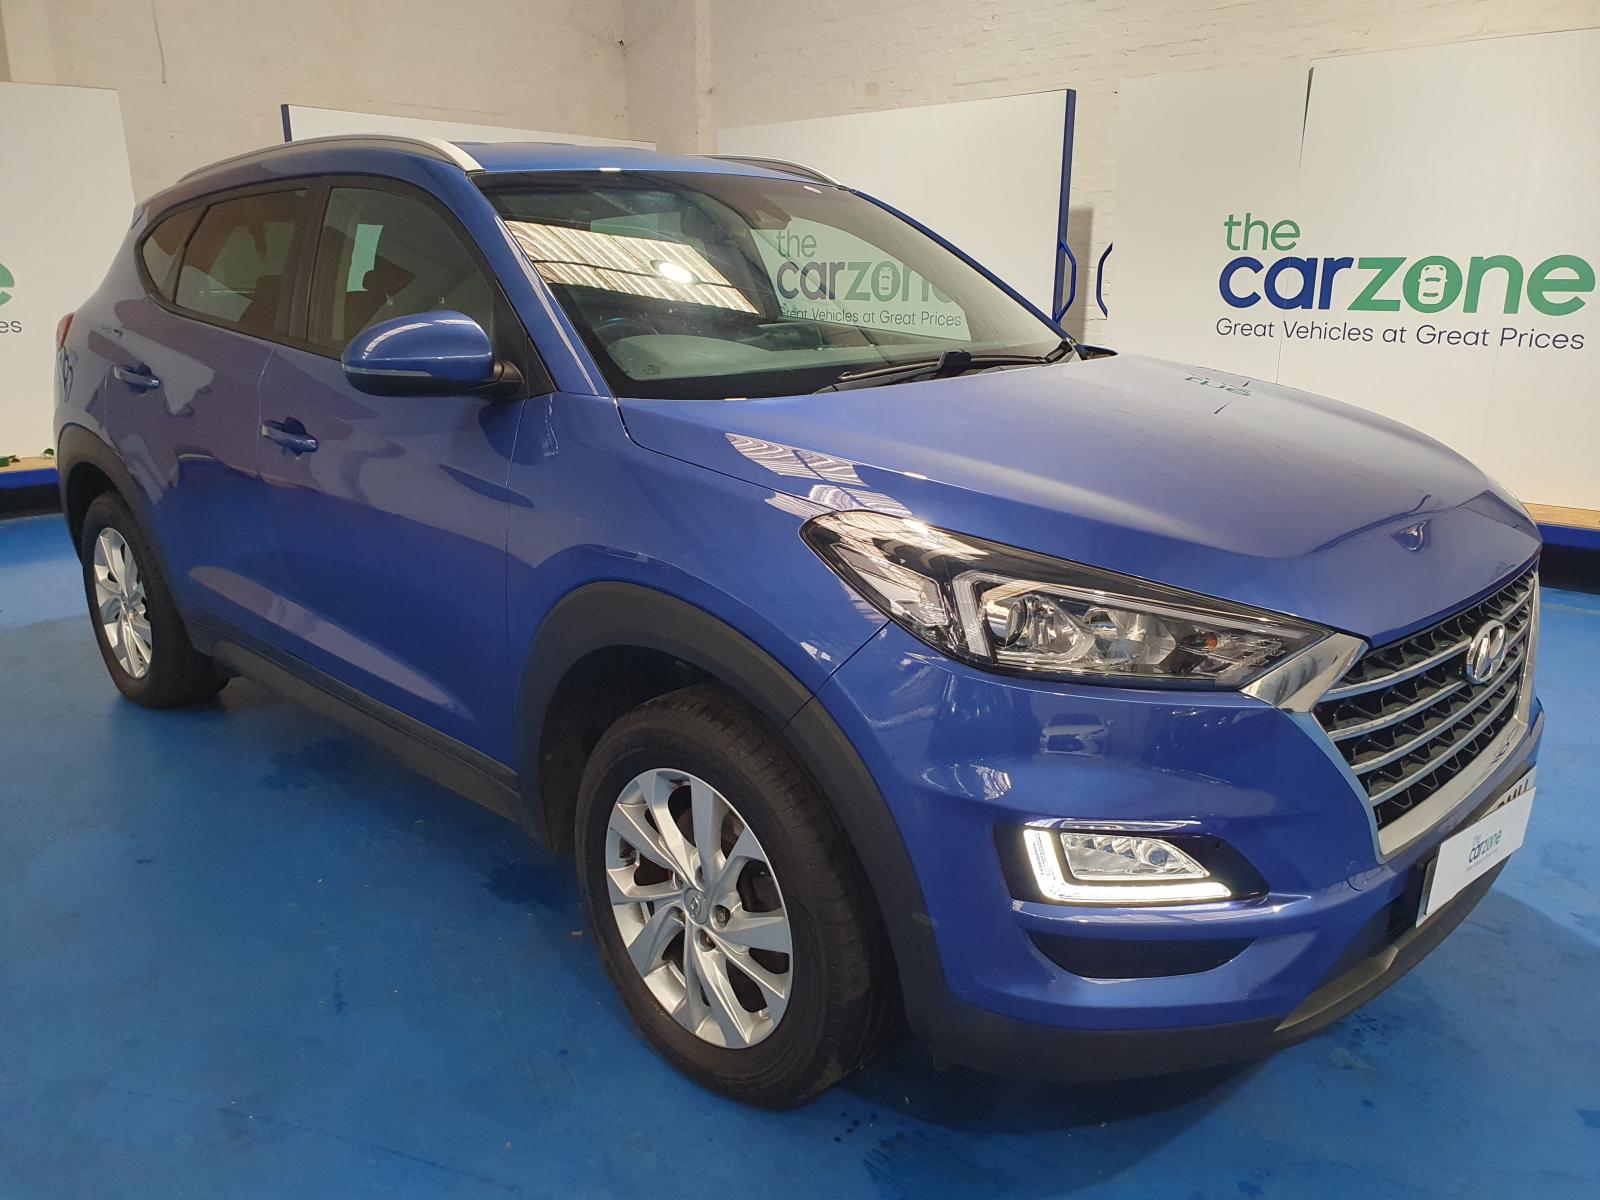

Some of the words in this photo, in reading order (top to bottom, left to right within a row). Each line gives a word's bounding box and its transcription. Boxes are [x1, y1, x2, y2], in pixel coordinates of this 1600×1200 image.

[776, 229, 818, 258] the
[1224, 212, 1301, 251] the
[1218, 254, 1596, 316] carzone
[811, 307, 859, 323] Vehicles
[862, 311, 876, 324] at
[879, 310, 917, 326] Great
[920, 311, 962, 327] Prices
[1216, 317, 1275, 339] Great
[1282, 320, 1374, 342] Vehicles
[1382, 325, 1408, 344] at
[1416, 324, 1491, 347] Great
[1499, 327, 1586, 350] Prices
[1468, 829, 1502, 863] carzone
